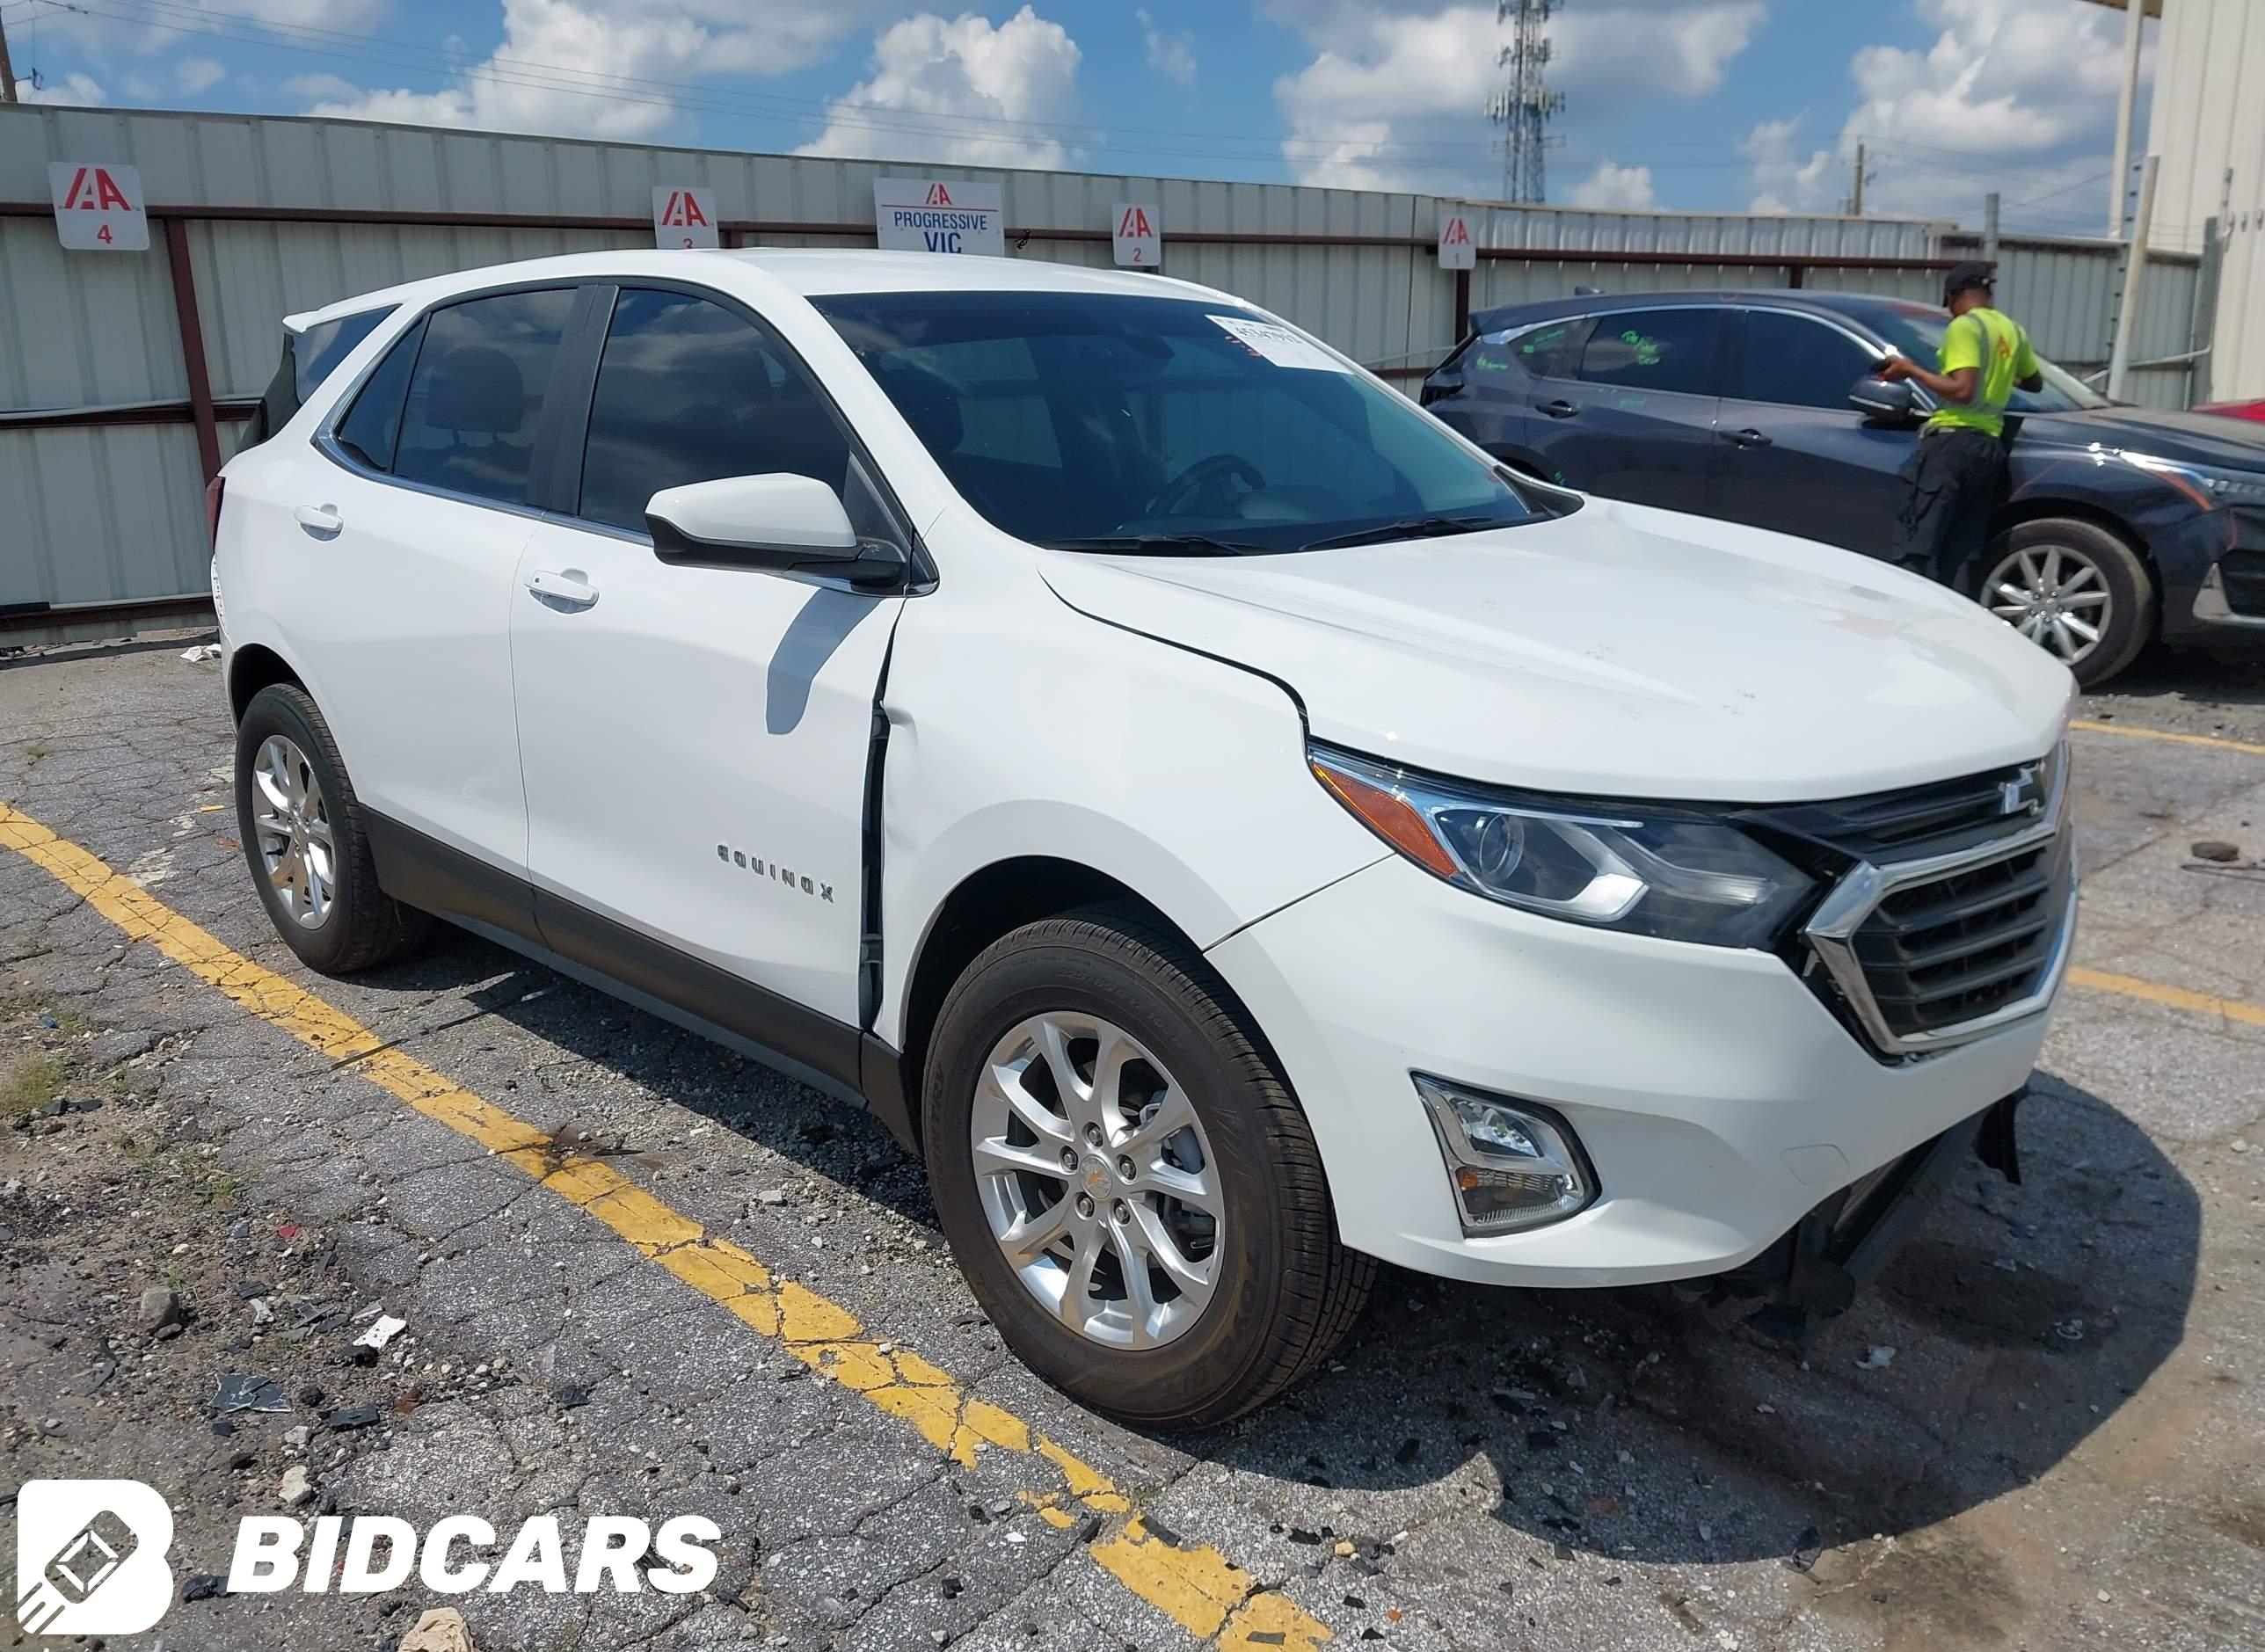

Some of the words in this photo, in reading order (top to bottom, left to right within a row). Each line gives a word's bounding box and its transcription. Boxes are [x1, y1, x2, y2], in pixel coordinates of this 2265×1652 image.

[893, 211, 987, 230] PROGRESSIVE
[97, 224, 113, 244] 4
[923, 231, 962, 254] VIC
[1133, 247, 1142, 262] 2
[1453, 252, 1460, 266] 1
[717, 844, 834, 904] EQUINOX
